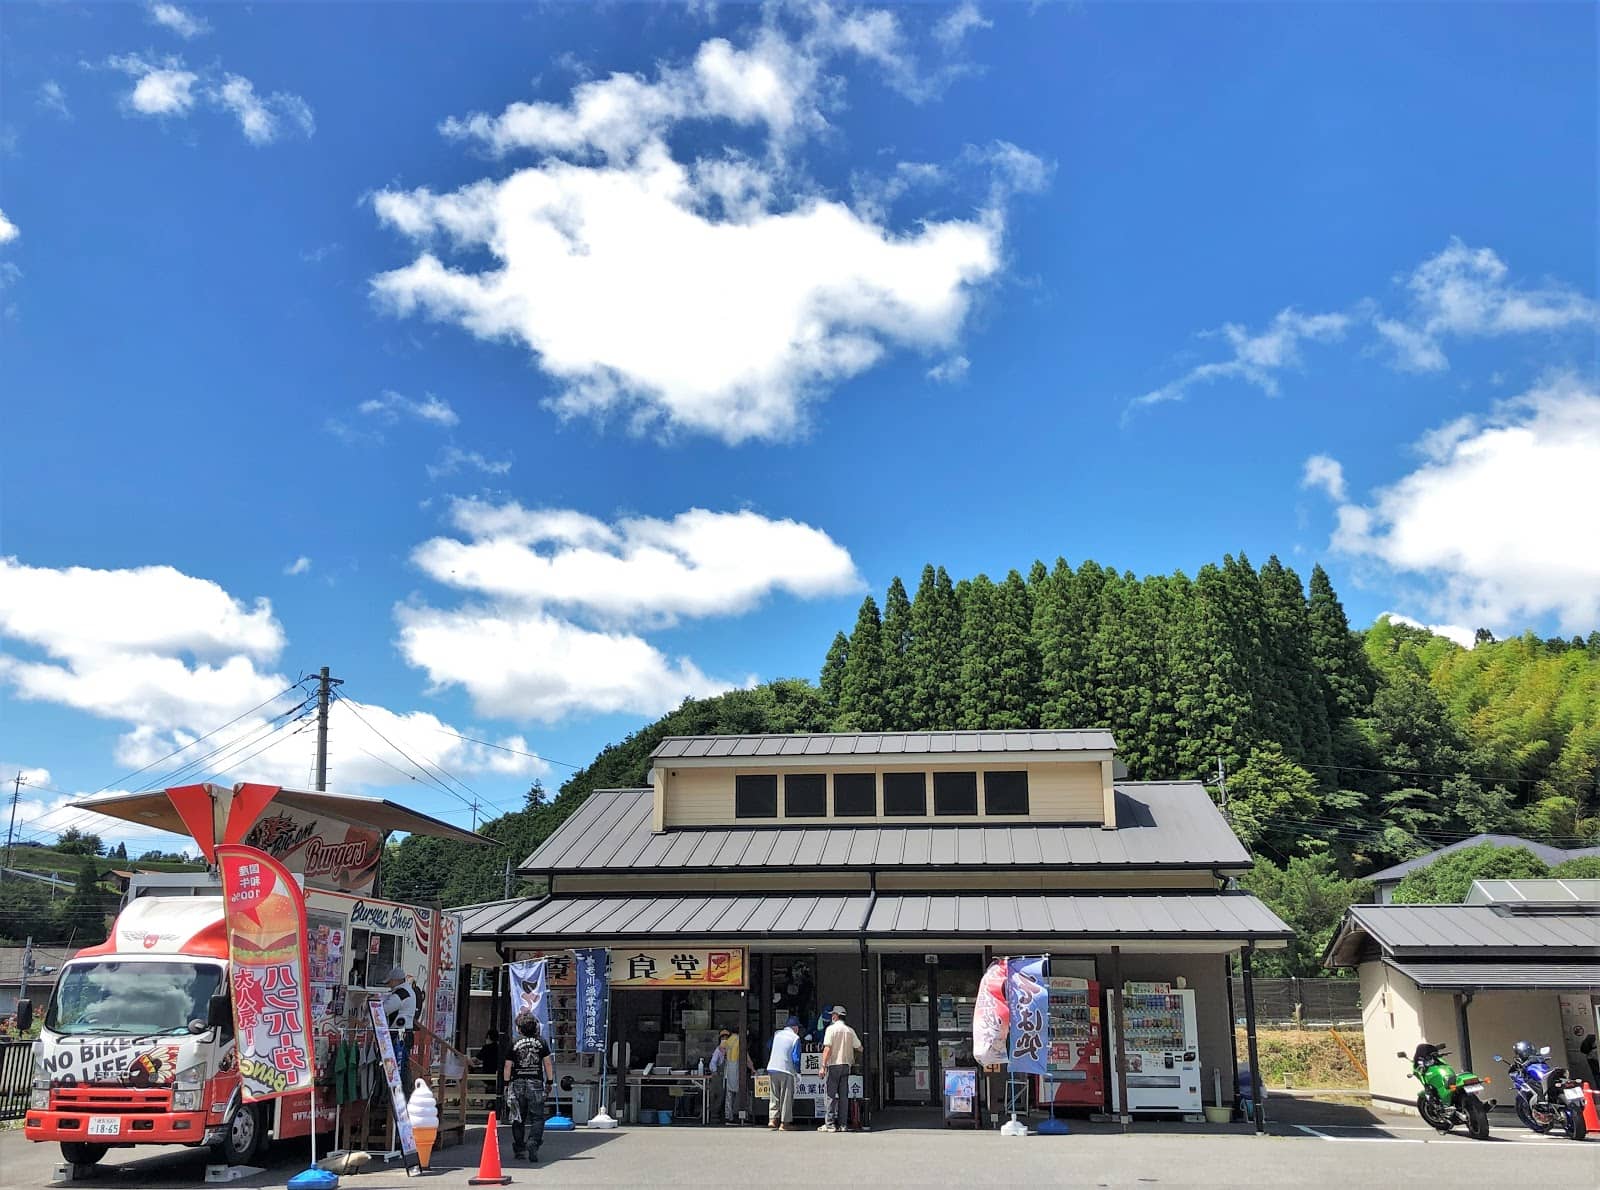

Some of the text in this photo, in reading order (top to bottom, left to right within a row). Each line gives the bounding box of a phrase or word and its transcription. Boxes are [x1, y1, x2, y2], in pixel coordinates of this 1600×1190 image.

[304, 836, 367, 881] Burgers
[350, 900, 414, 931] Burger Shop
[44, 1050, 73, 1073] NO
[82, 1054, 128, 1083] LIFE
